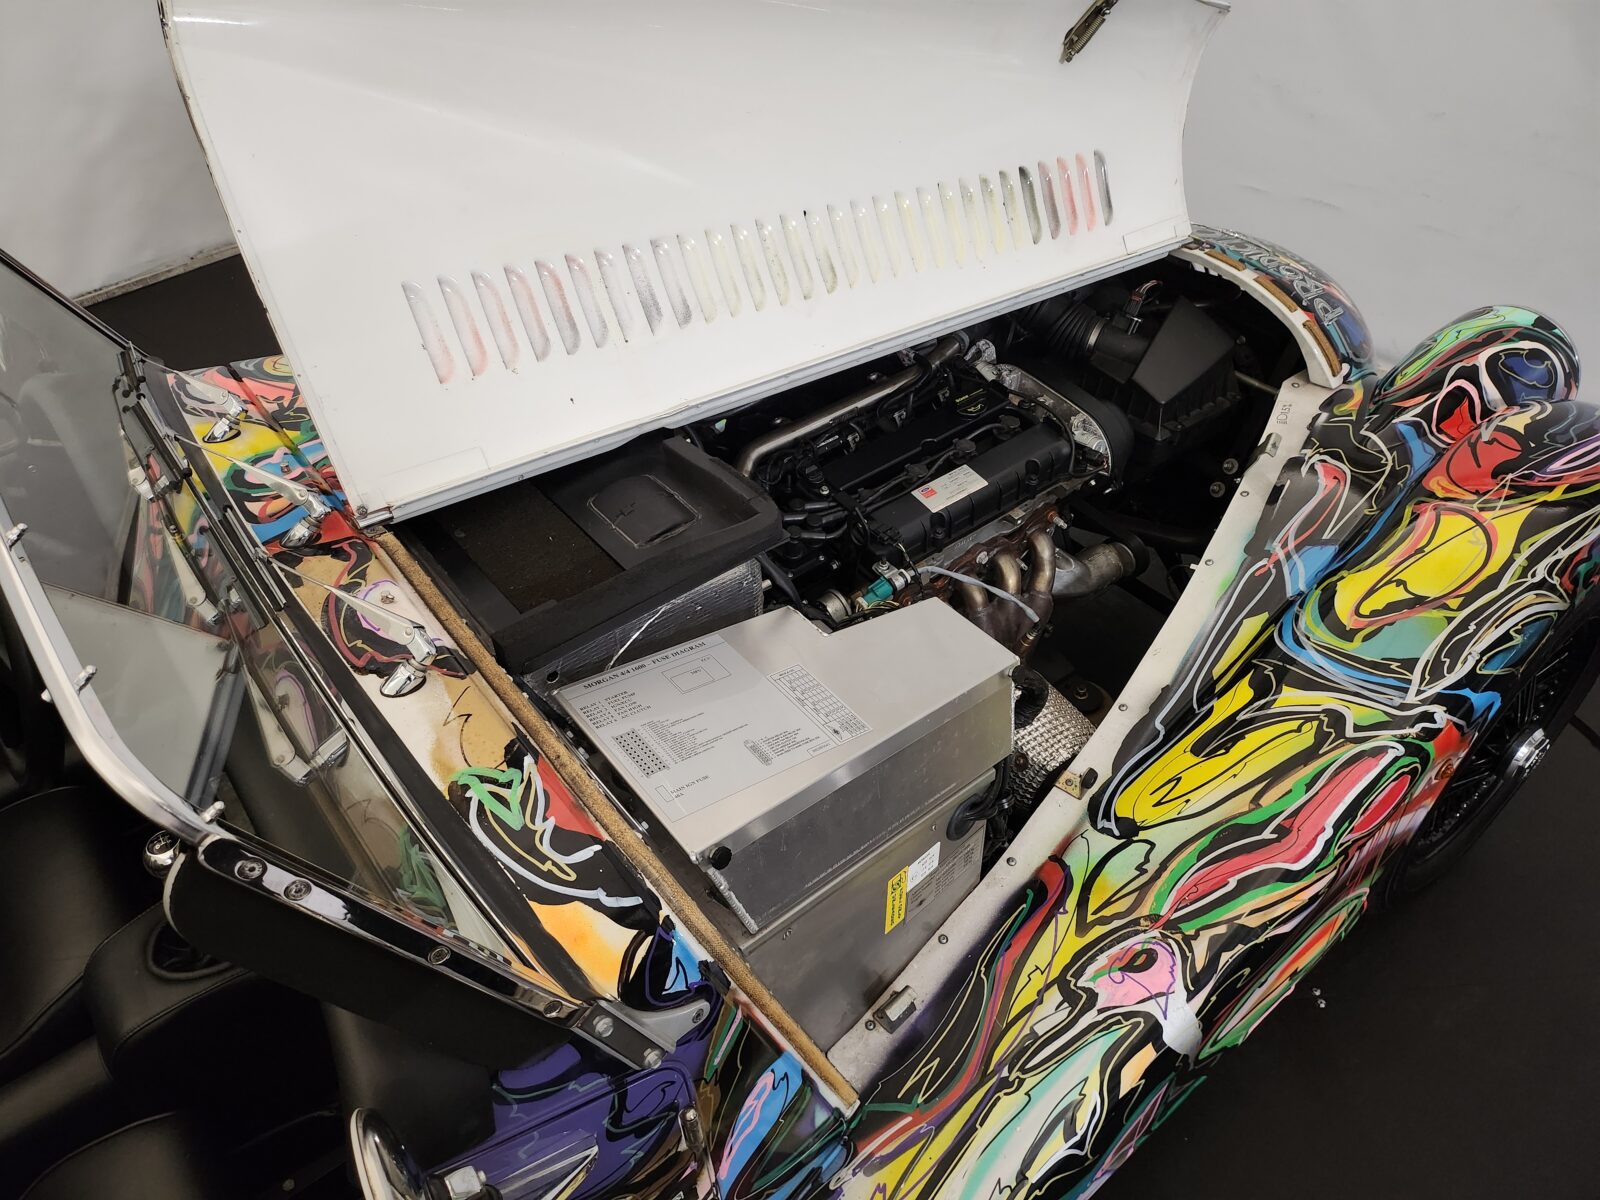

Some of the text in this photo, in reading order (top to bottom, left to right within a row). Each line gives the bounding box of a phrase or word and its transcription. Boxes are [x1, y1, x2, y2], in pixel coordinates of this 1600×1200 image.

[583, 673, 619, 689] MORGAN
[631, 663, 646, 672] 1600
[651, 654, 670, 664] FUSE
[671, 641, 706, 657] DIAGRAM
[580, 702, 597, 710] RELAY
[604, 691, 628, 701] STARTER
[583, 706, 600, 714] RELAY
[586, 710, 602, 718] RELAY
[589, 713, 606, 721] RELAY
[592, 717, 609, 725] RELAY
[595, 720, 613, 729] RELAY
[630, 705, 651, 715] CLUTCH
[670, 786, 685, 794] MAIN
[695, 775, 709, 783] FUSE
